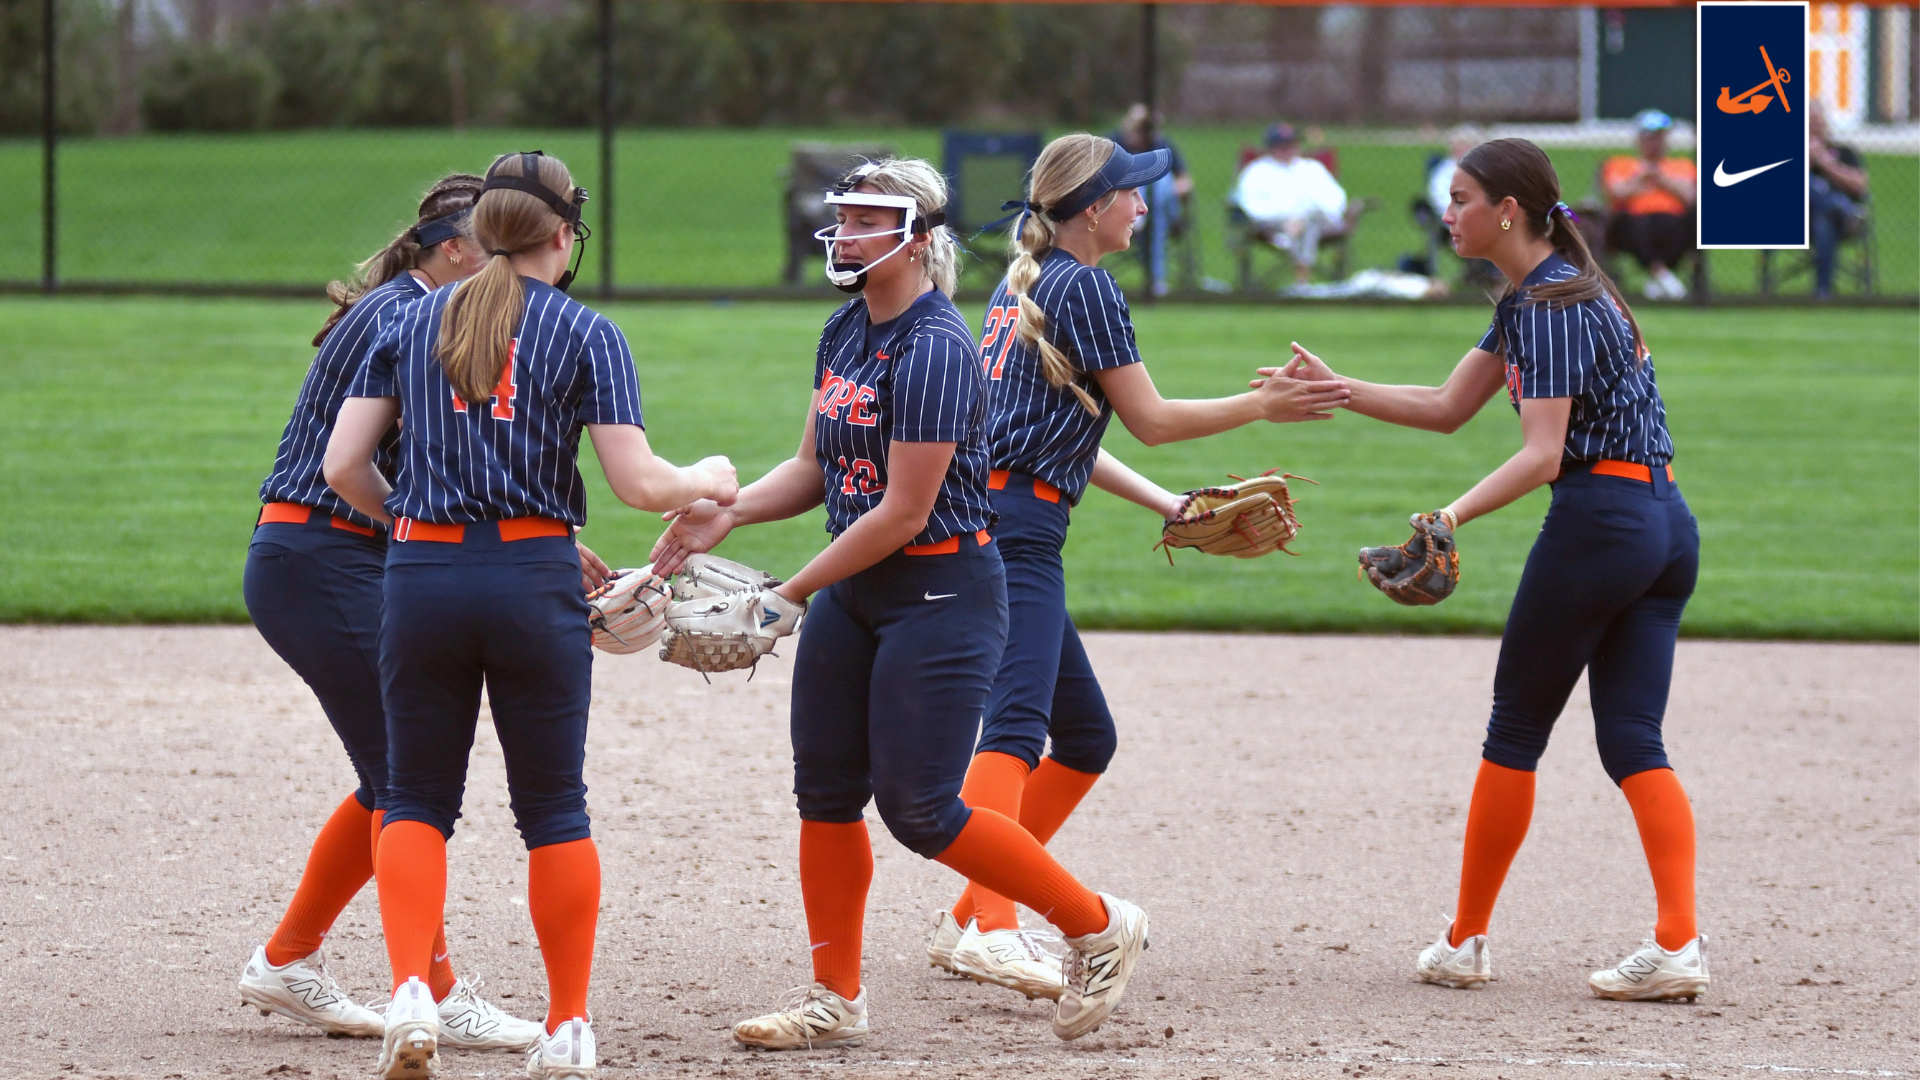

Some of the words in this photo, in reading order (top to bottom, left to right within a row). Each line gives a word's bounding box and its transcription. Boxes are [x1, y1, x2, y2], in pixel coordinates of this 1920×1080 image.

[980, 306, 1019, 380] 27
[1617, 956, 1658, 983] N
[287, 979, 339, 1010] N
[445, 1009, 500, 1038] N
